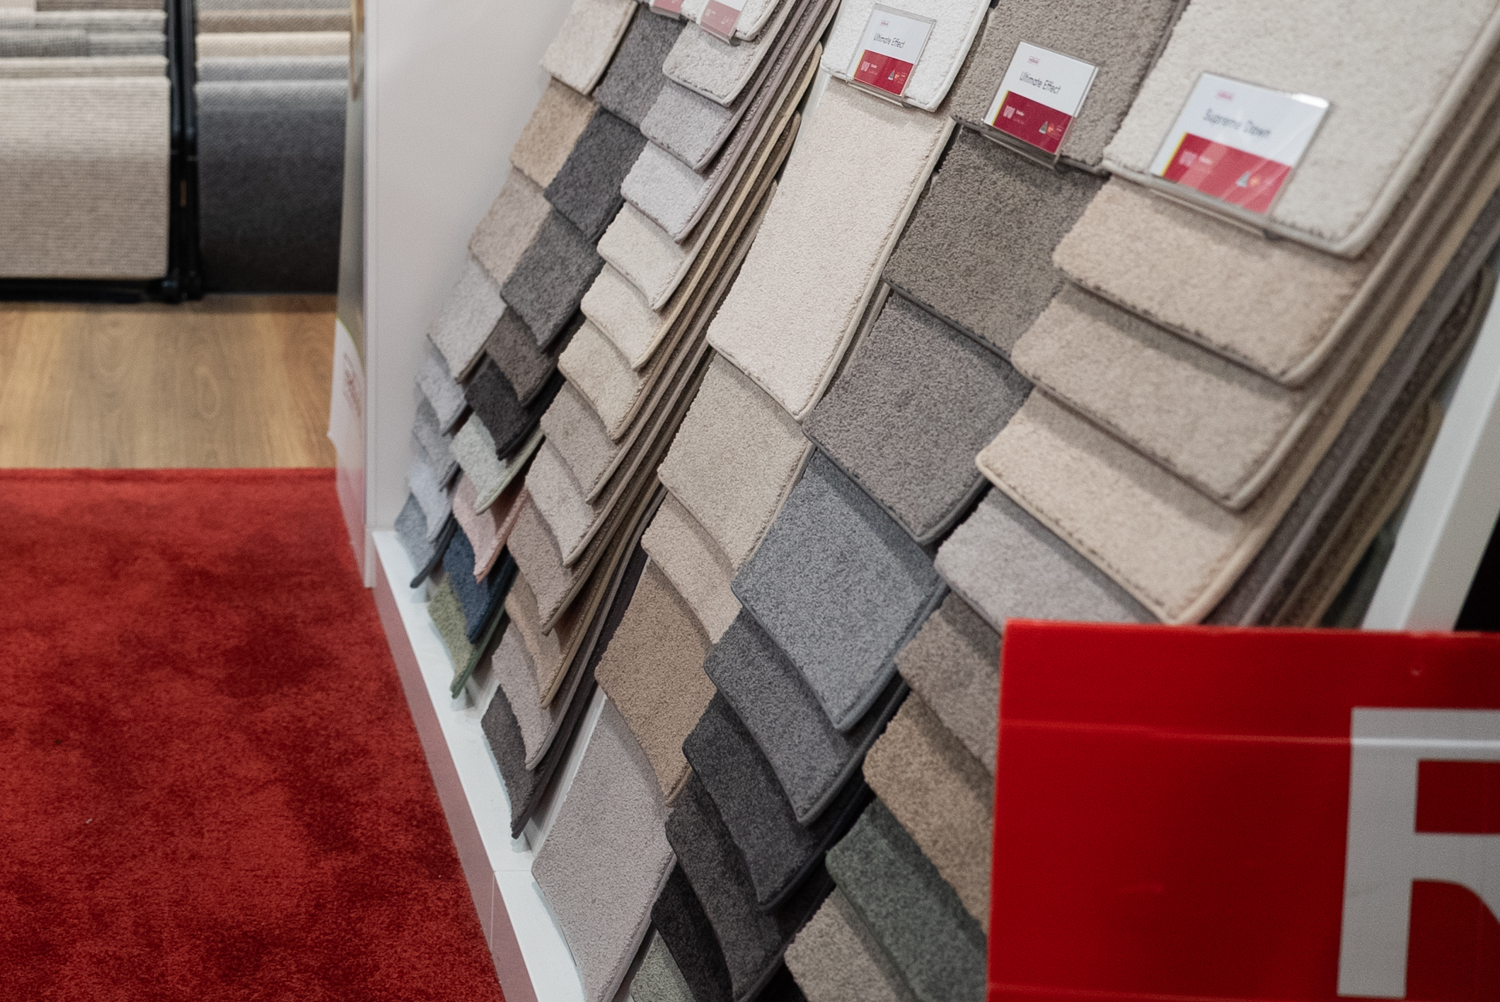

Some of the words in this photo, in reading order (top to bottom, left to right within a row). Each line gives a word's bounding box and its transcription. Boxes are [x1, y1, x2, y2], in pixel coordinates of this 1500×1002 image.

[874, 32, 891, 45] Ultimate
[891, 37, 905, 48] Effect
[1019, 71, 1042, 88] Ultimate
[1042, 80, 1061, 94] Effect
[1203, 108, 1241, 130] Supreme
